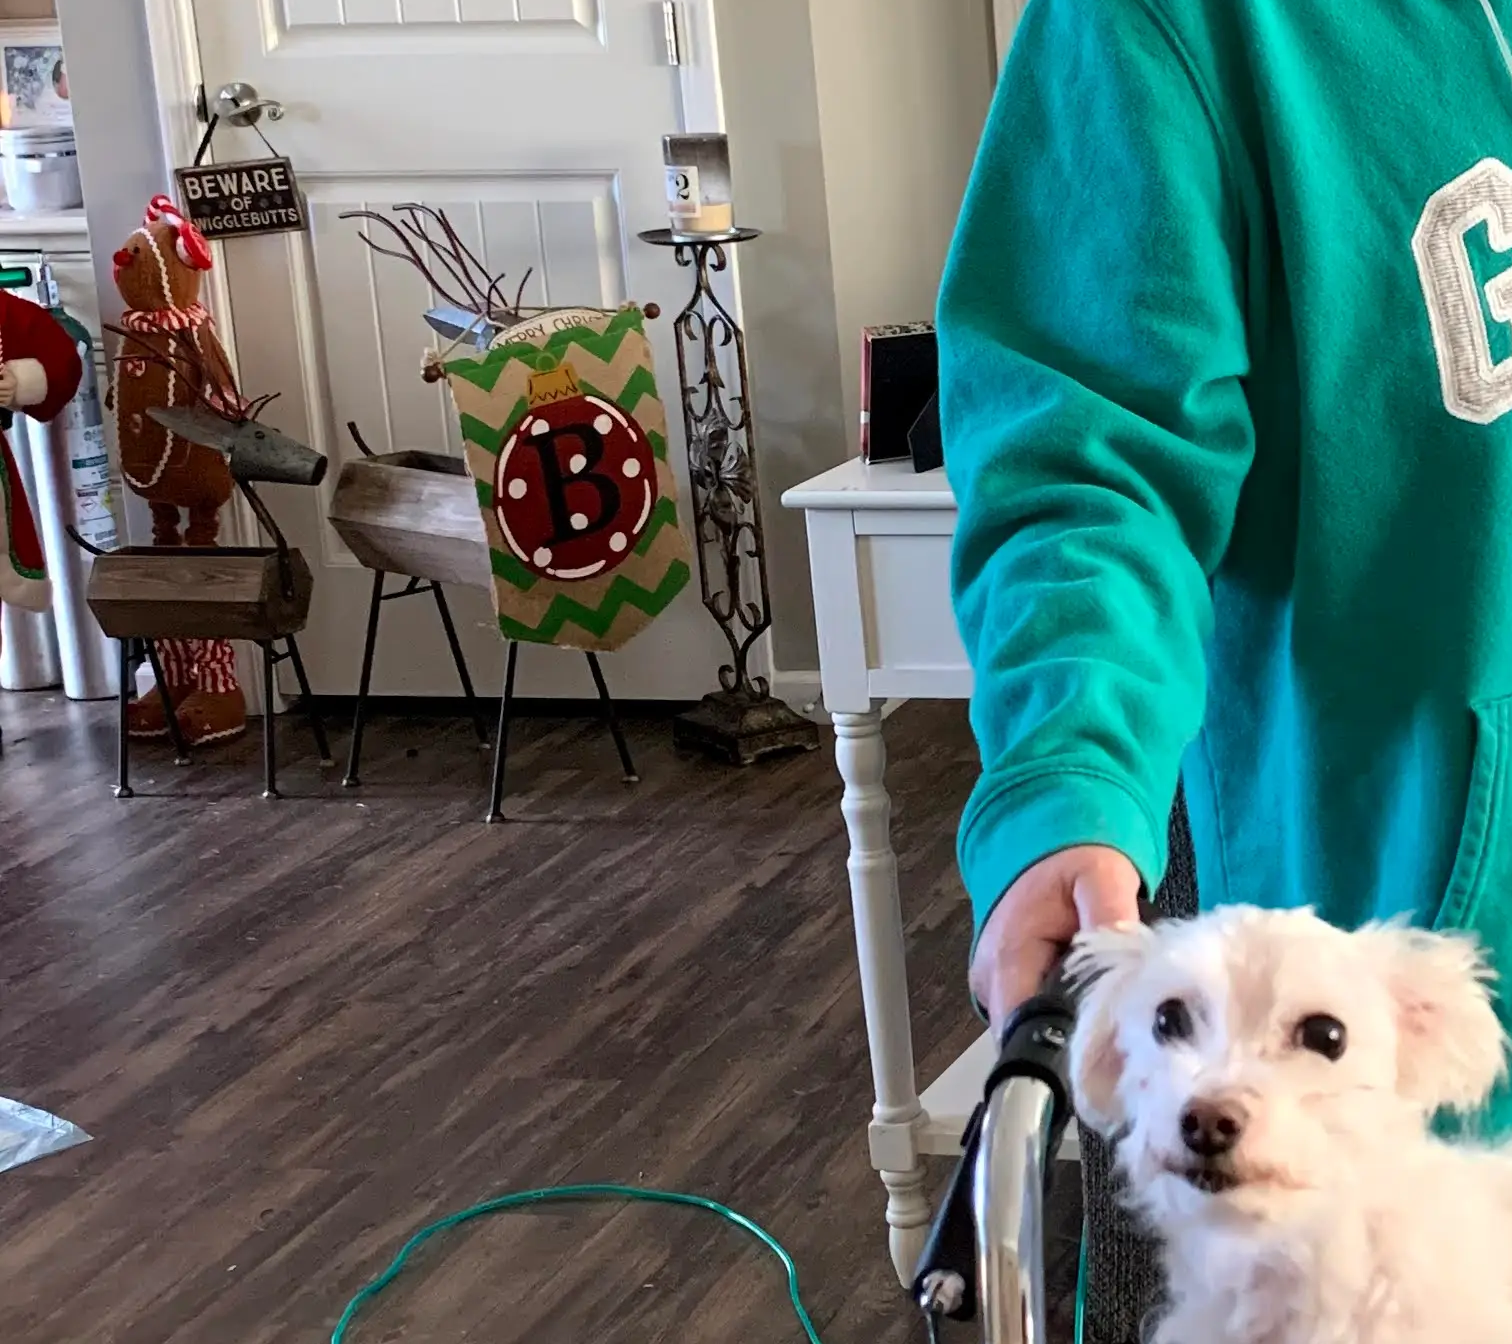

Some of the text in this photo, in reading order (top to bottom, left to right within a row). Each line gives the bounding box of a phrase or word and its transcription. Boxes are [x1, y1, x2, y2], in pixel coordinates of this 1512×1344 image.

[184, 167, 289, 200] BEWARE
[231, 196, 253, 211] OF
[193, 208, 298, 232] WIGGLEBUTTS
[522, 423, 621, 547] B
